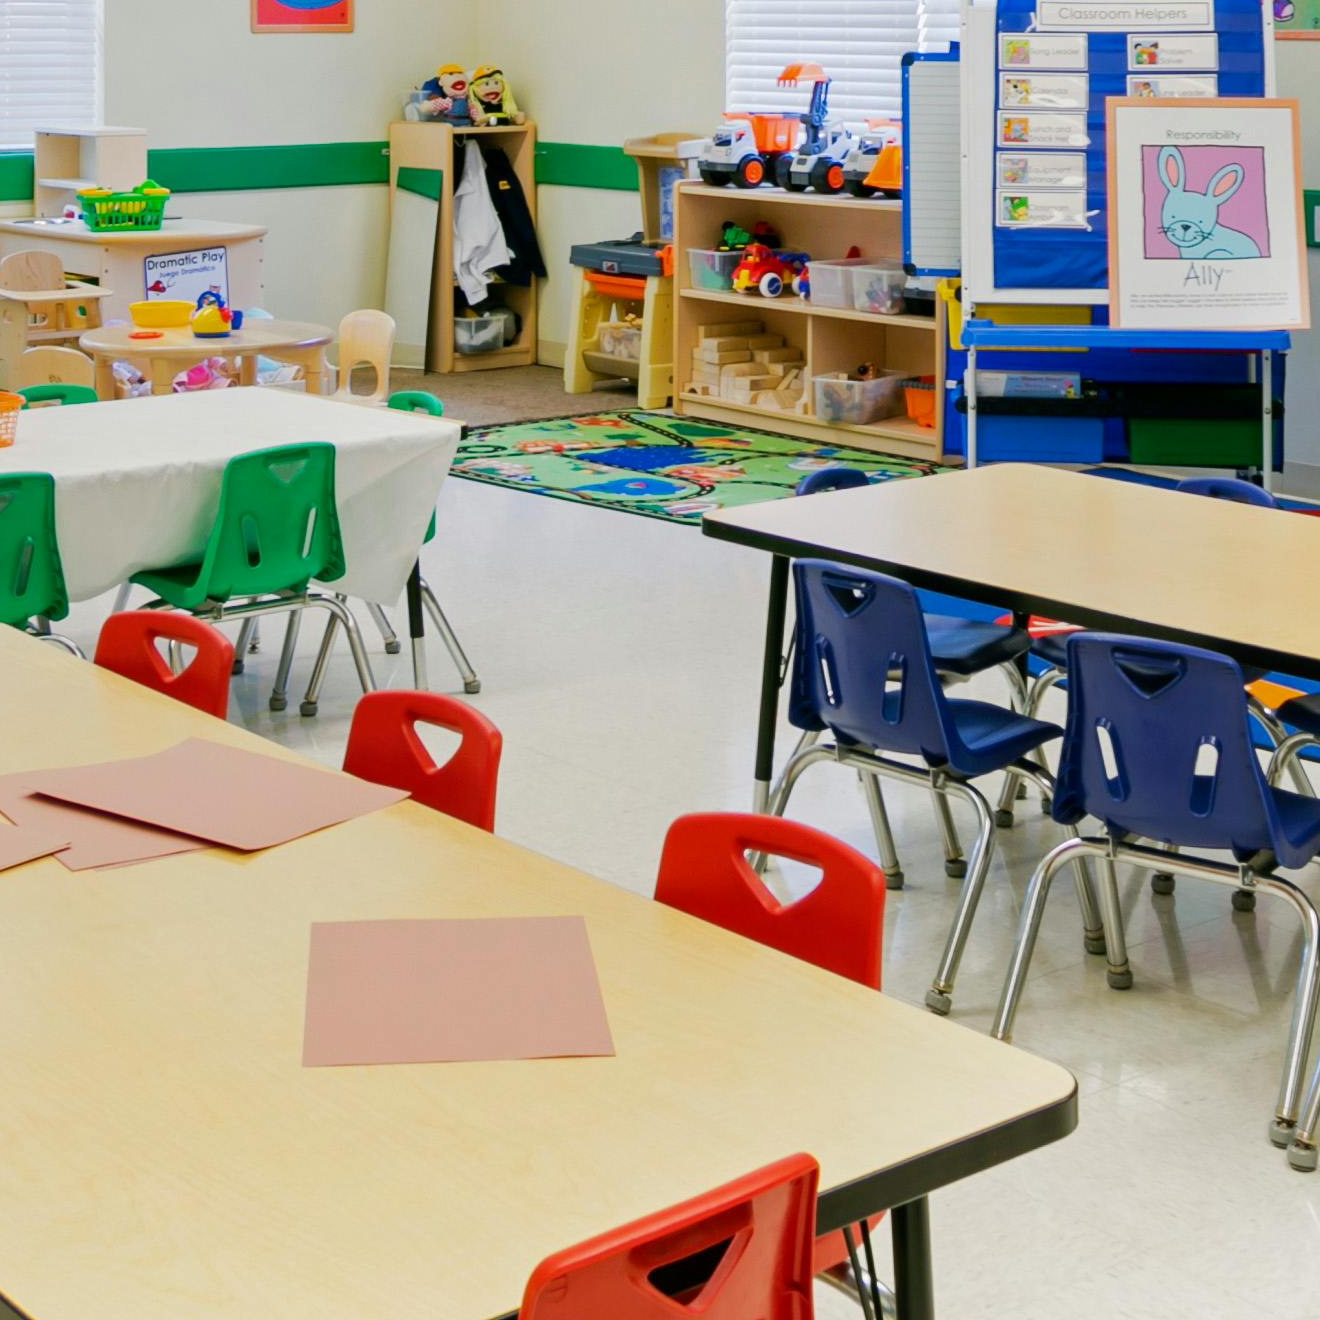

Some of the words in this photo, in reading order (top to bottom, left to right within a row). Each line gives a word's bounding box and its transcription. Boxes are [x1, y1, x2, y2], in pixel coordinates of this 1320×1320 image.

[1058, 8, 1131, 20] Classroom
[1134, 8, 1188, 23] Helpers
[1166, 130, 1241, 142] Responsibility
[148, 254, 199, 271] Dramatic
[202, 252, 225, 263] Play
[1183, 262, 1224, 292] Ally
